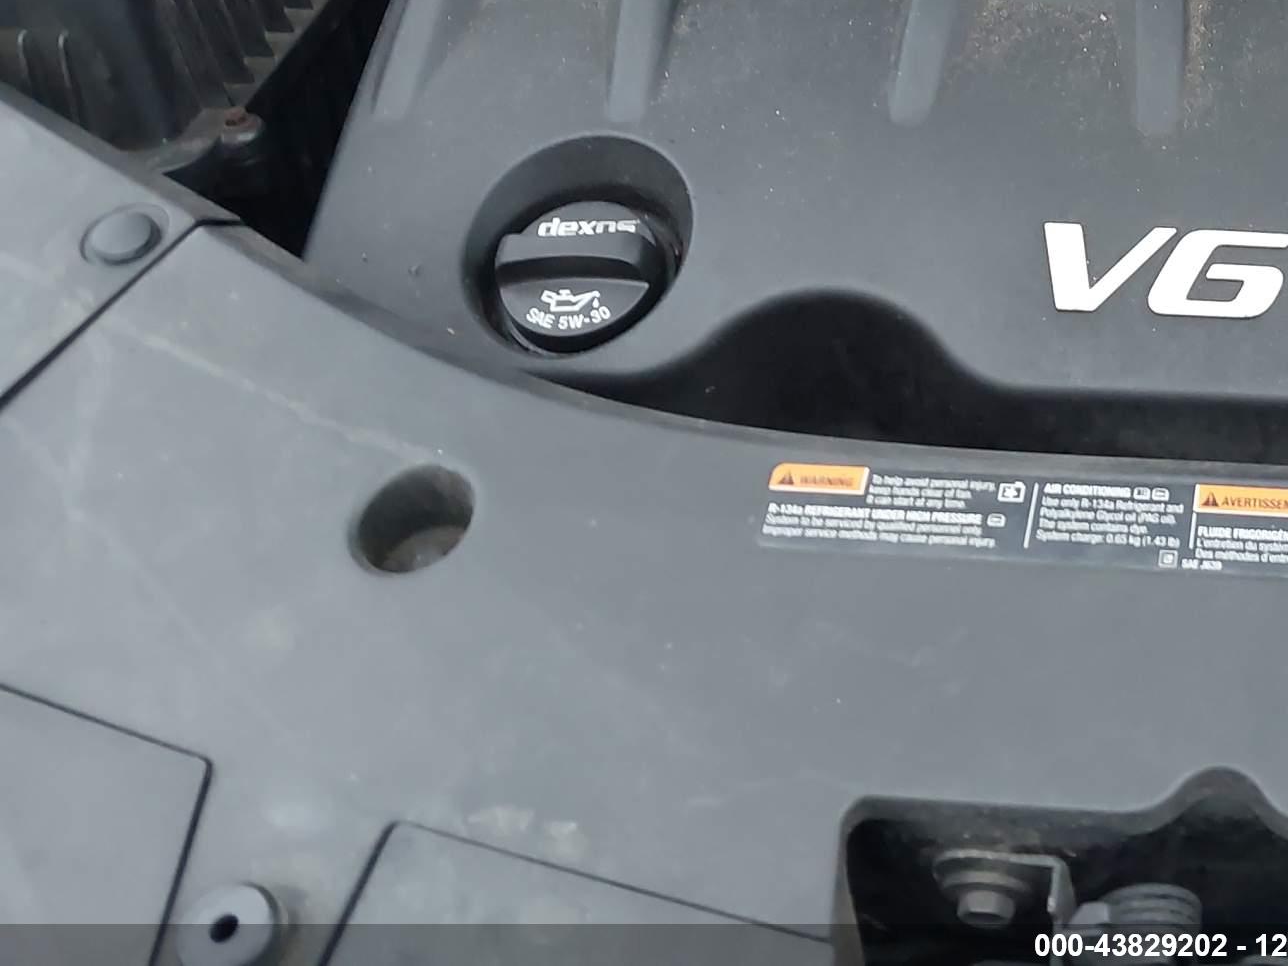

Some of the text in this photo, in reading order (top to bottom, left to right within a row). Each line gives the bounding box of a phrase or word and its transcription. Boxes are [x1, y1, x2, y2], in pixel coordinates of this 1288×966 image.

[526, 306, 611, 330] SAE 5W-30
[1044, 483, 1131, 498] AIR CONDITIONING
[1198, 526, 1232, 538] FLUIDE
